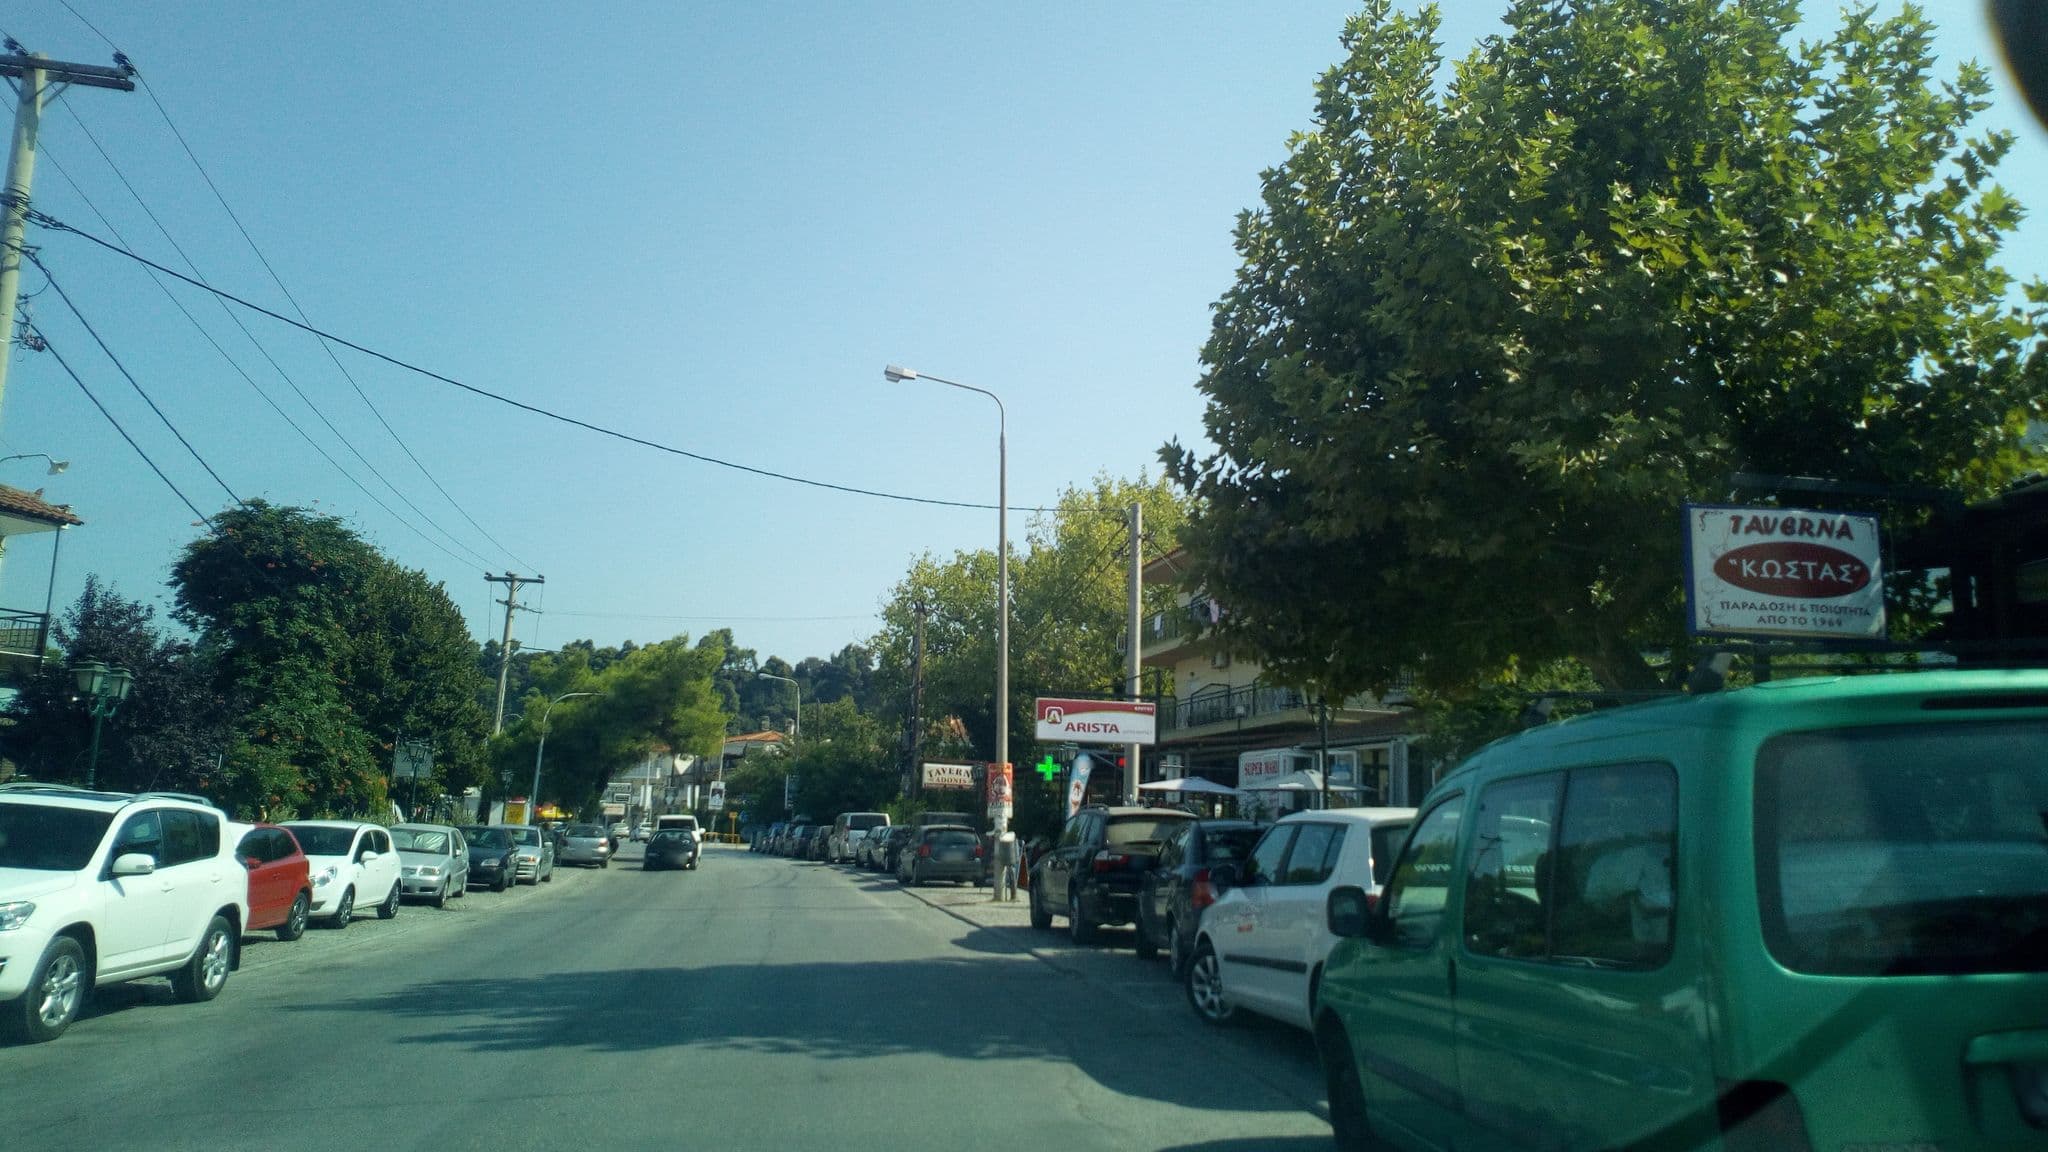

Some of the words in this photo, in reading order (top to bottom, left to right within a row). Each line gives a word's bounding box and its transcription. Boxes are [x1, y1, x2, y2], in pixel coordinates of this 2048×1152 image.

[1730, 515, 1853, 540] TAVERNA
[1720, 600, 1796, 613] ΠΑΡΑΔΟΣΗ
[1810, 604, 1872, 617] ΠΟΙΟΤΗΤΑ
[1756, 615, 1788, 625] ΑΠΟ
[1064, 721, 1120, 734] ARISTA
[928, 766, 975, 780] TAVERN
